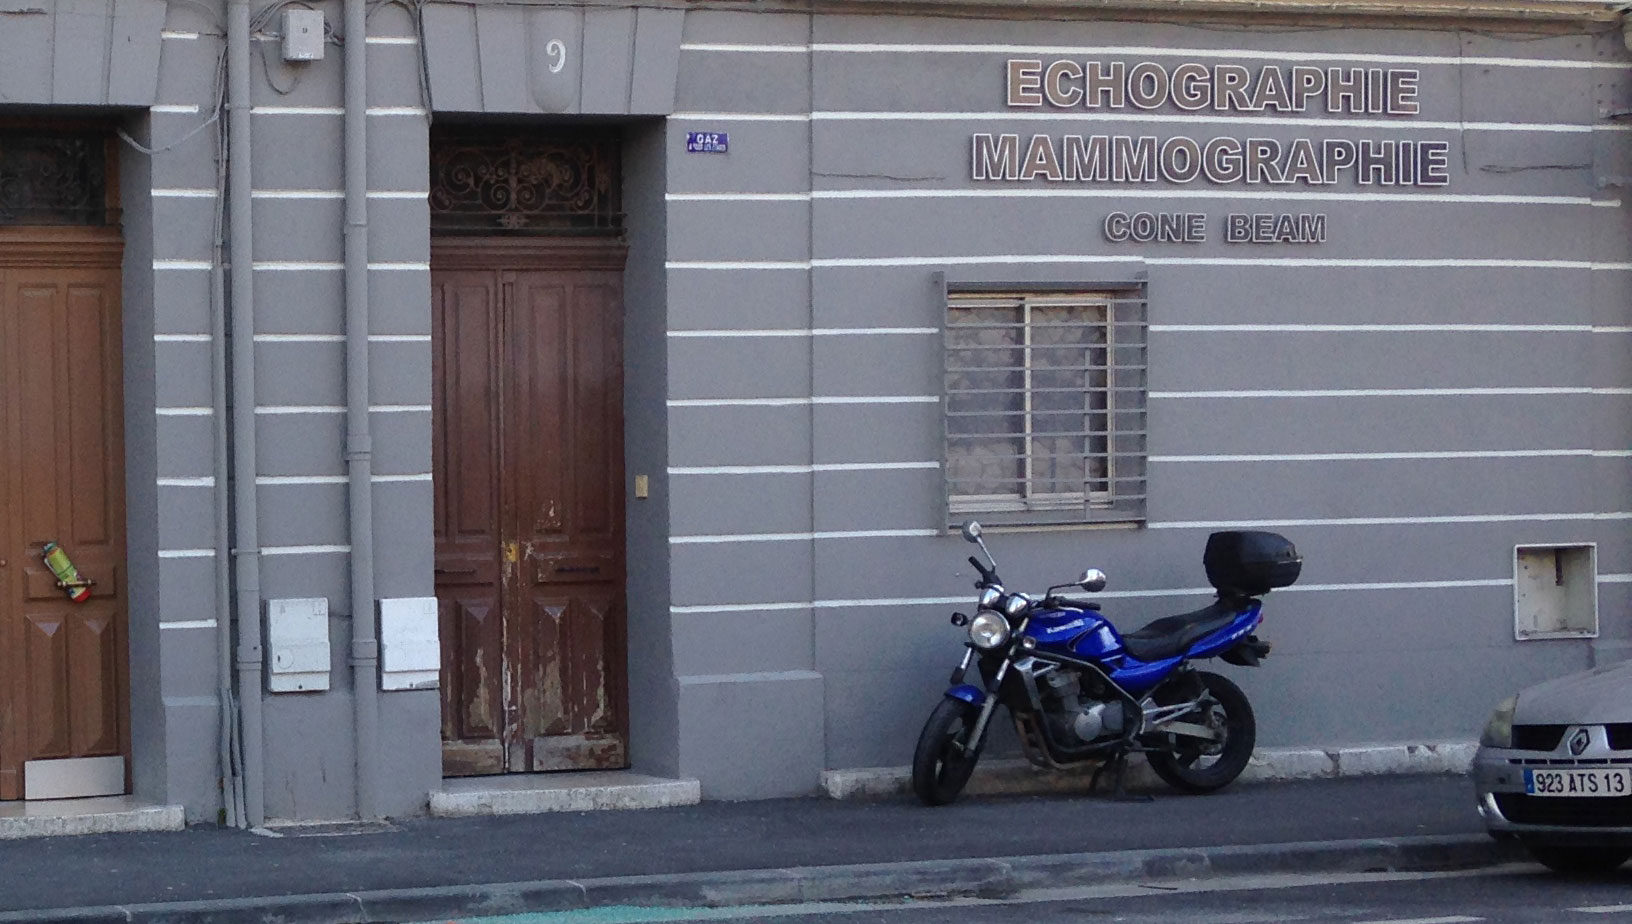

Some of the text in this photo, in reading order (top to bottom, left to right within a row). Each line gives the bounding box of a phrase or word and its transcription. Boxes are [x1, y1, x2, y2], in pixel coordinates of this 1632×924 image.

[547, 39, 566, 73] 9
[1007, 59, 1420, 115] ECHOGRAPHIE
[972, 133, 1450, 186] MAMMOGRAPHIE
[1104, 211, 1327, 243] CONE BEAM
[1535, 772, 1625, 793] 923 ATS 13
